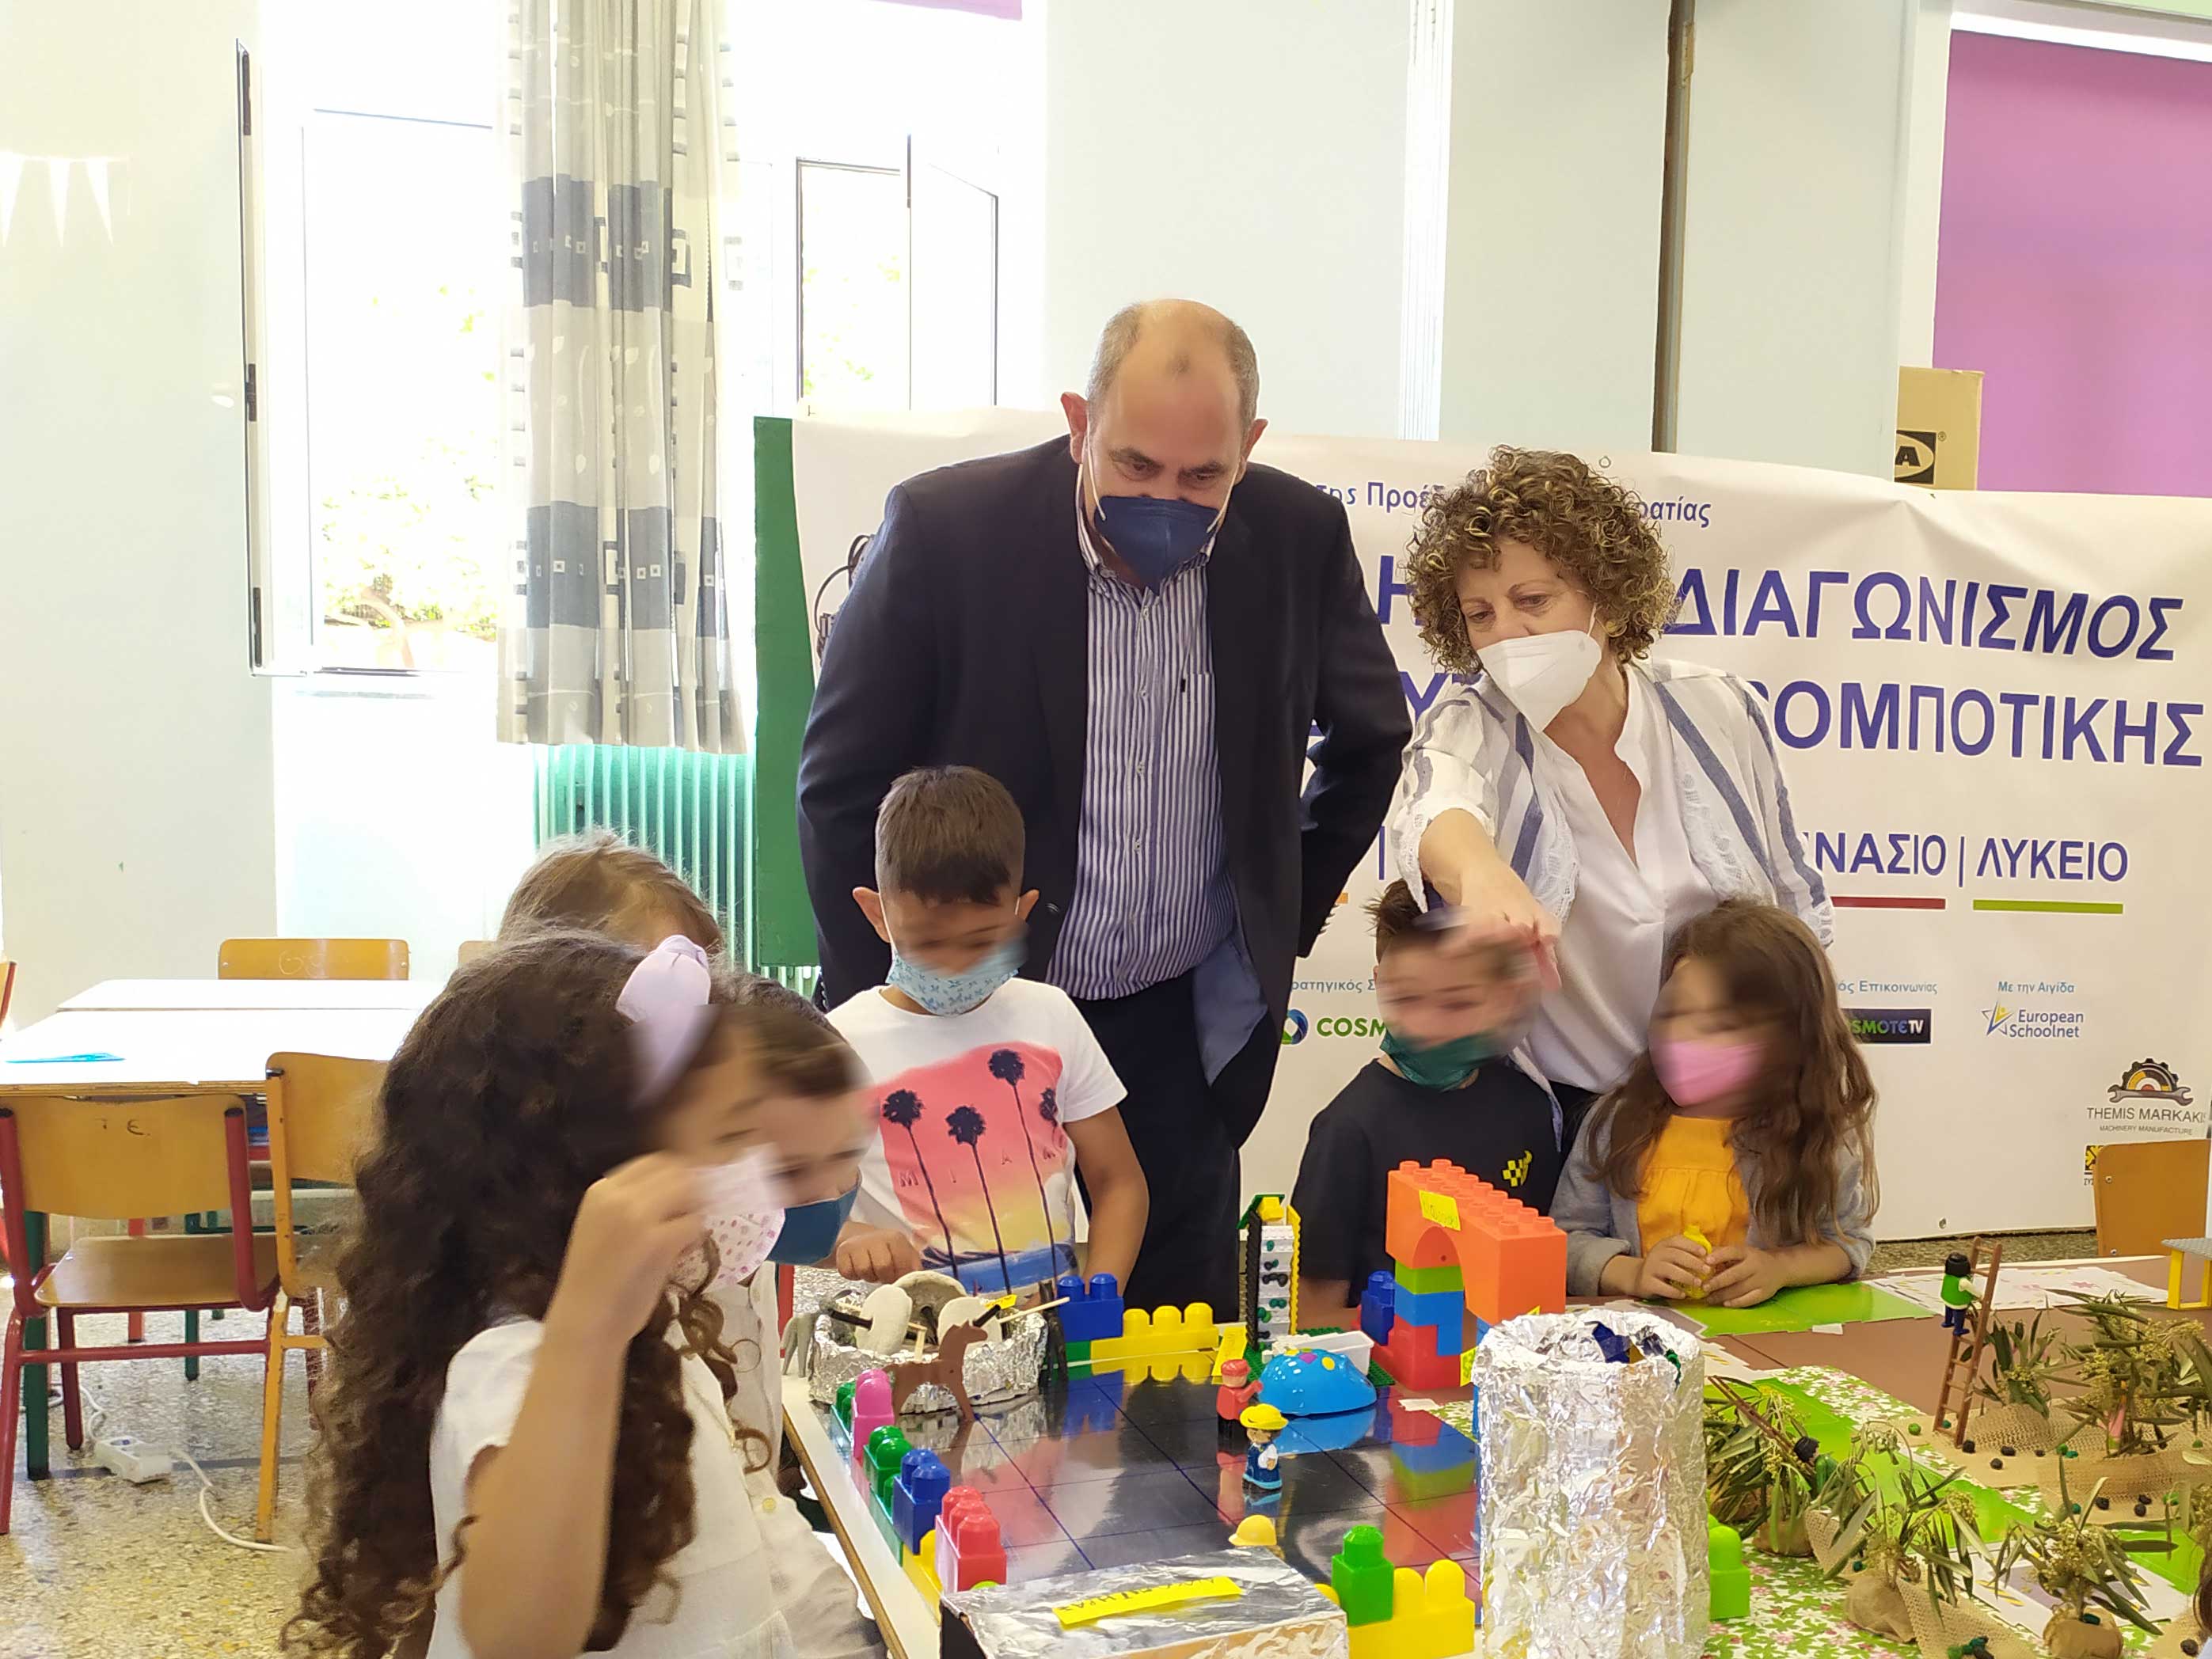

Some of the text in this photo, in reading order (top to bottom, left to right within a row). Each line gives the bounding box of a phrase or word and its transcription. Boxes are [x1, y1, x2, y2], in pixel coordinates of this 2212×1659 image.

[1663, 568, 2183, 661] ΔΙΑΓΩΝΙΣΜΟΣ
[1746, 680, 2204, 766] ΟΜΠΟΤΙΚΗΣ
[1801, 832, 2128, 882] ΝΑΣΙΟ ΛΥΚΕΙΟ
[1859, 980, 1938, 994] Επικοινωνίας
[1997, 981, 2013, 993] Με
[2017, 983, 2035, 994] την
[2018, 1008, 2085, 1027] European
[1848, 1019, 1925, 1035] SMOTETV
[2009, 1023, 2081, 1038] Schoolnet
[2087, 1107, 2136, 1121] THEMIS
[2138, 1125, 2193, 1136] MANUFACTURE
